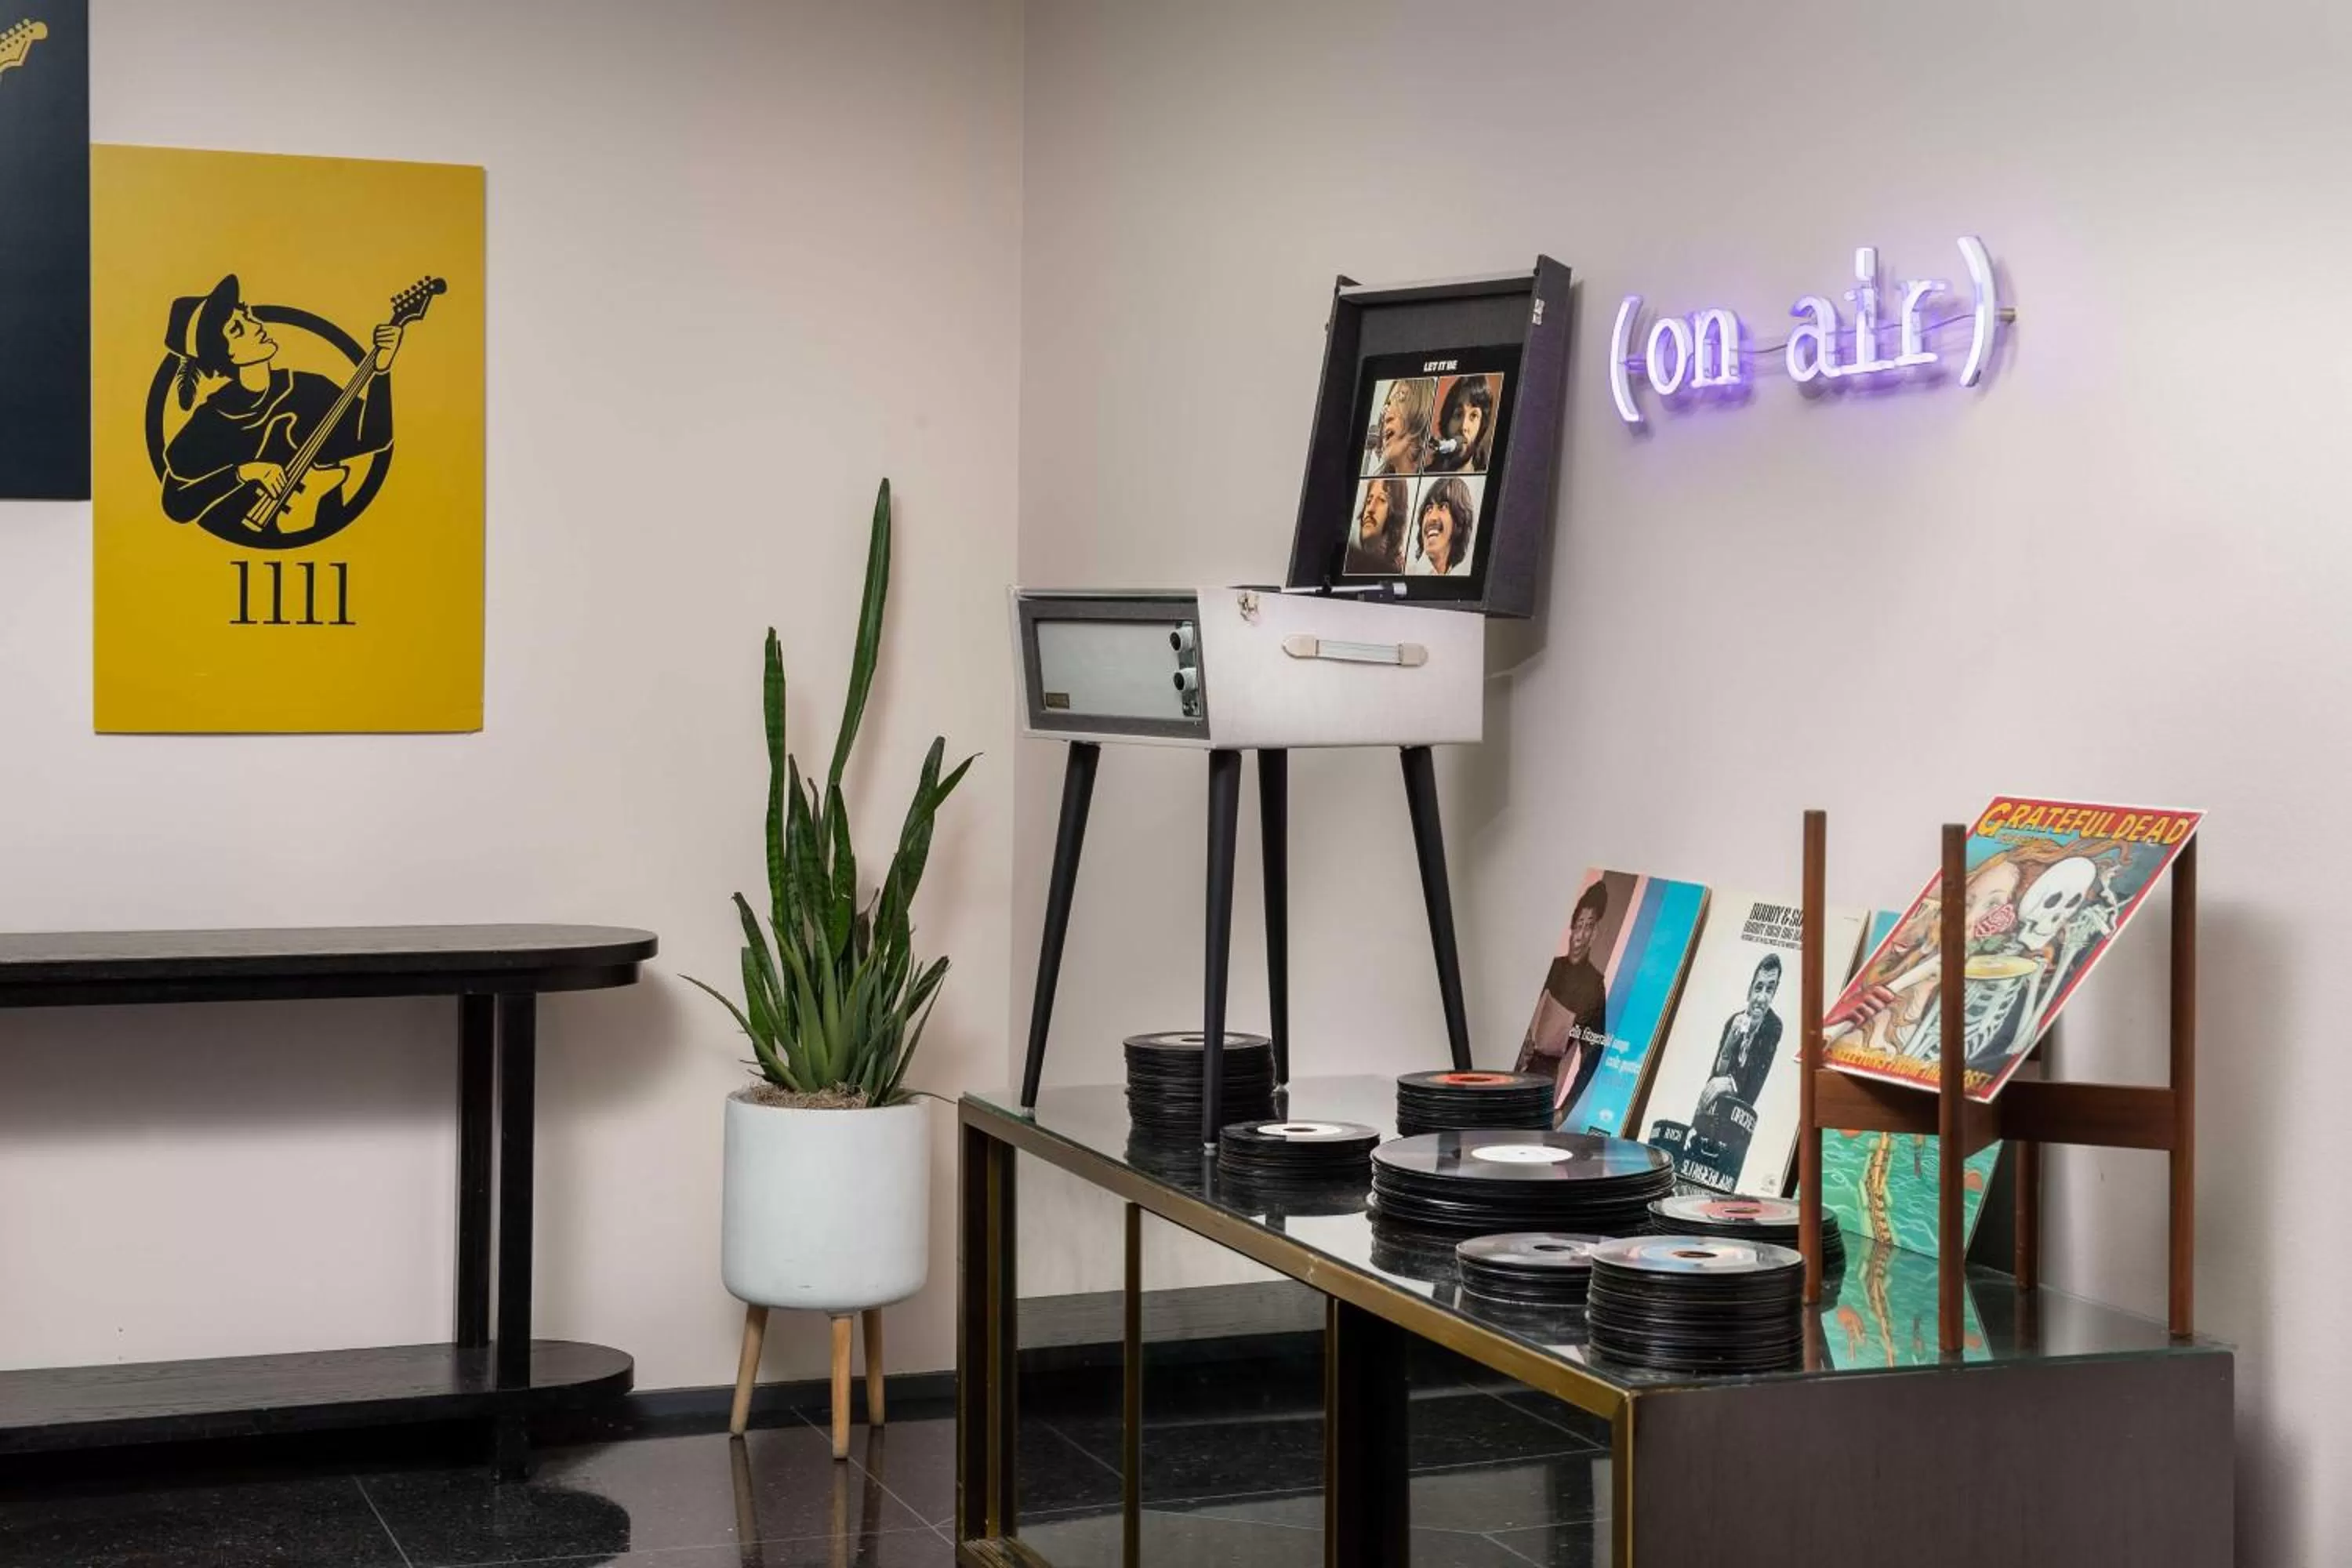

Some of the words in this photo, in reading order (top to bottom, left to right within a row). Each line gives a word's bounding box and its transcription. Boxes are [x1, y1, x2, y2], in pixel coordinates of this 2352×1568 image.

[1423, 361, 1438, 372] LET
[1437, 361, 1446, 371] IT
[229, 561, 356, 625] 1111
[1976, 802, 2115, 837] GRATEFUL
[2113, 814, 2190, 844] DEAD
